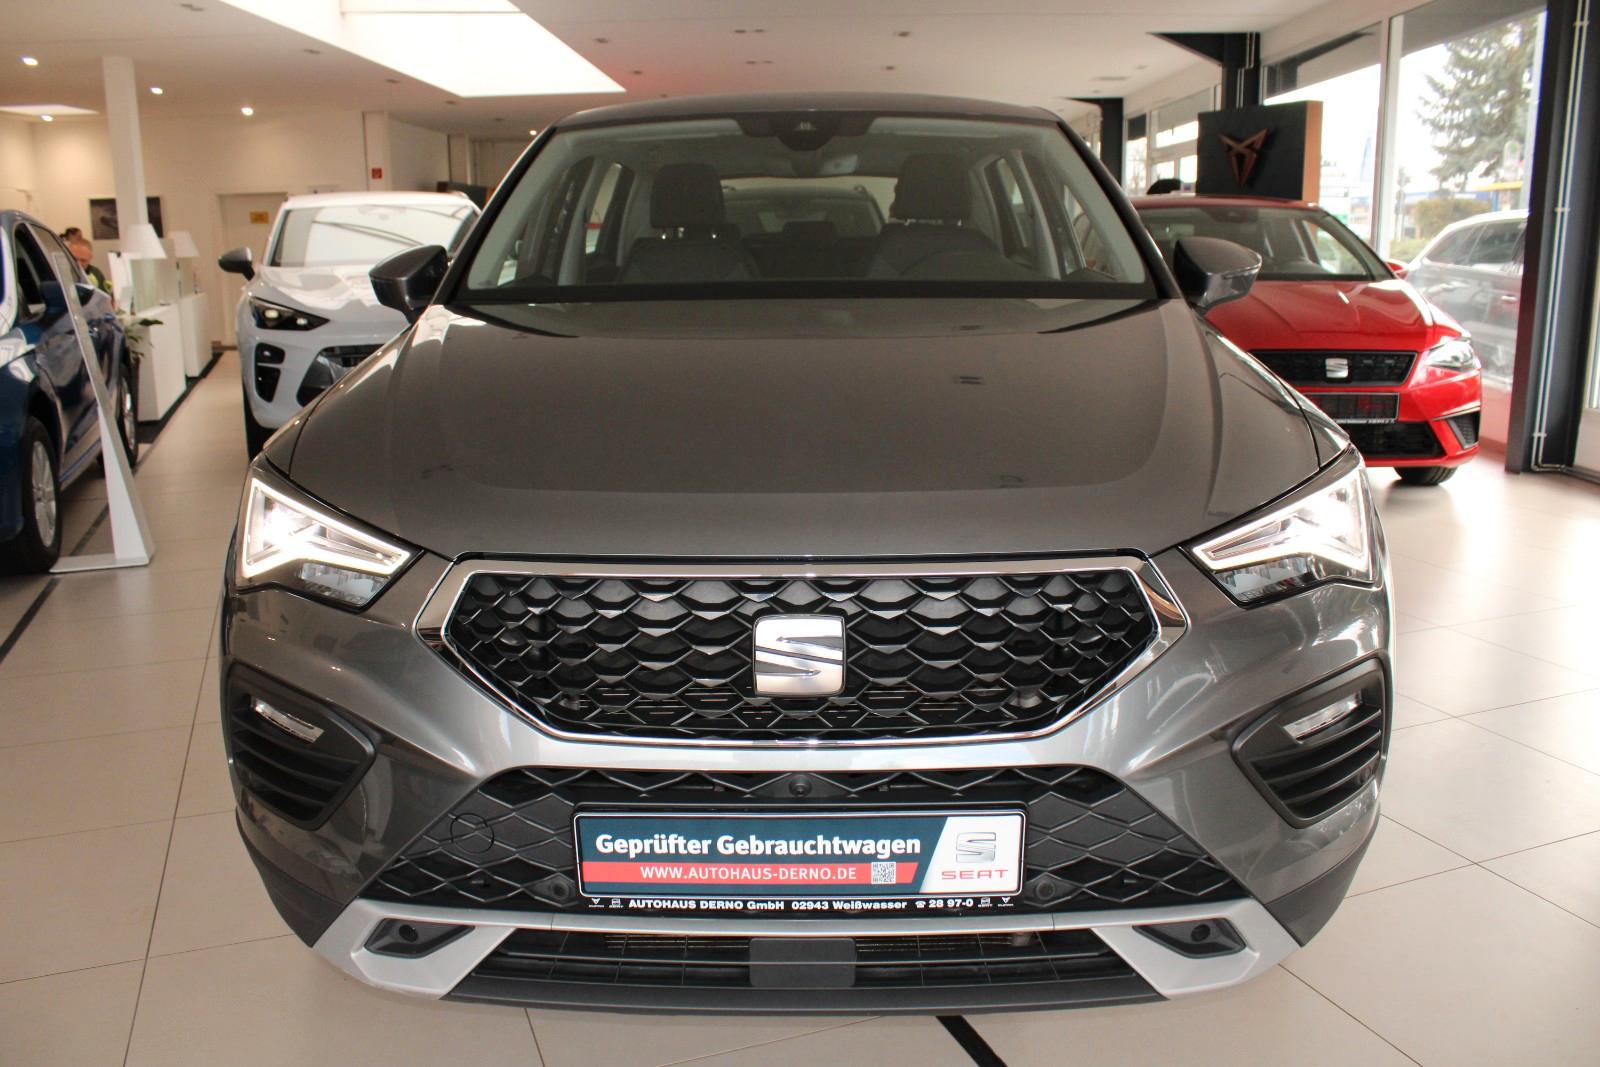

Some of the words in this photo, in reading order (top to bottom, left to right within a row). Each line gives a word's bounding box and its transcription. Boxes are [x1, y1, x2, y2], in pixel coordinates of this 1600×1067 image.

[595, 833, 712, 859] Geprüfter
[716, 834, 921, 859] Gebrauchtwagen
[640, 866, 857, 881] WWW.AUTOHAUS-DERNO.DE
[941, 869, 1009, 880] SEAT
[628, 899, 697, 910] AUTOHAUS
[699, 900, 744, 910] DERNO
[746, 900, 785, 910] GmbH
[791, 900, 829, 910] 02943
[832, 900, 908, 910] Weißwasser
[928, 899, 944, 909] 28
[946, 898, 974, 908] 97-0
